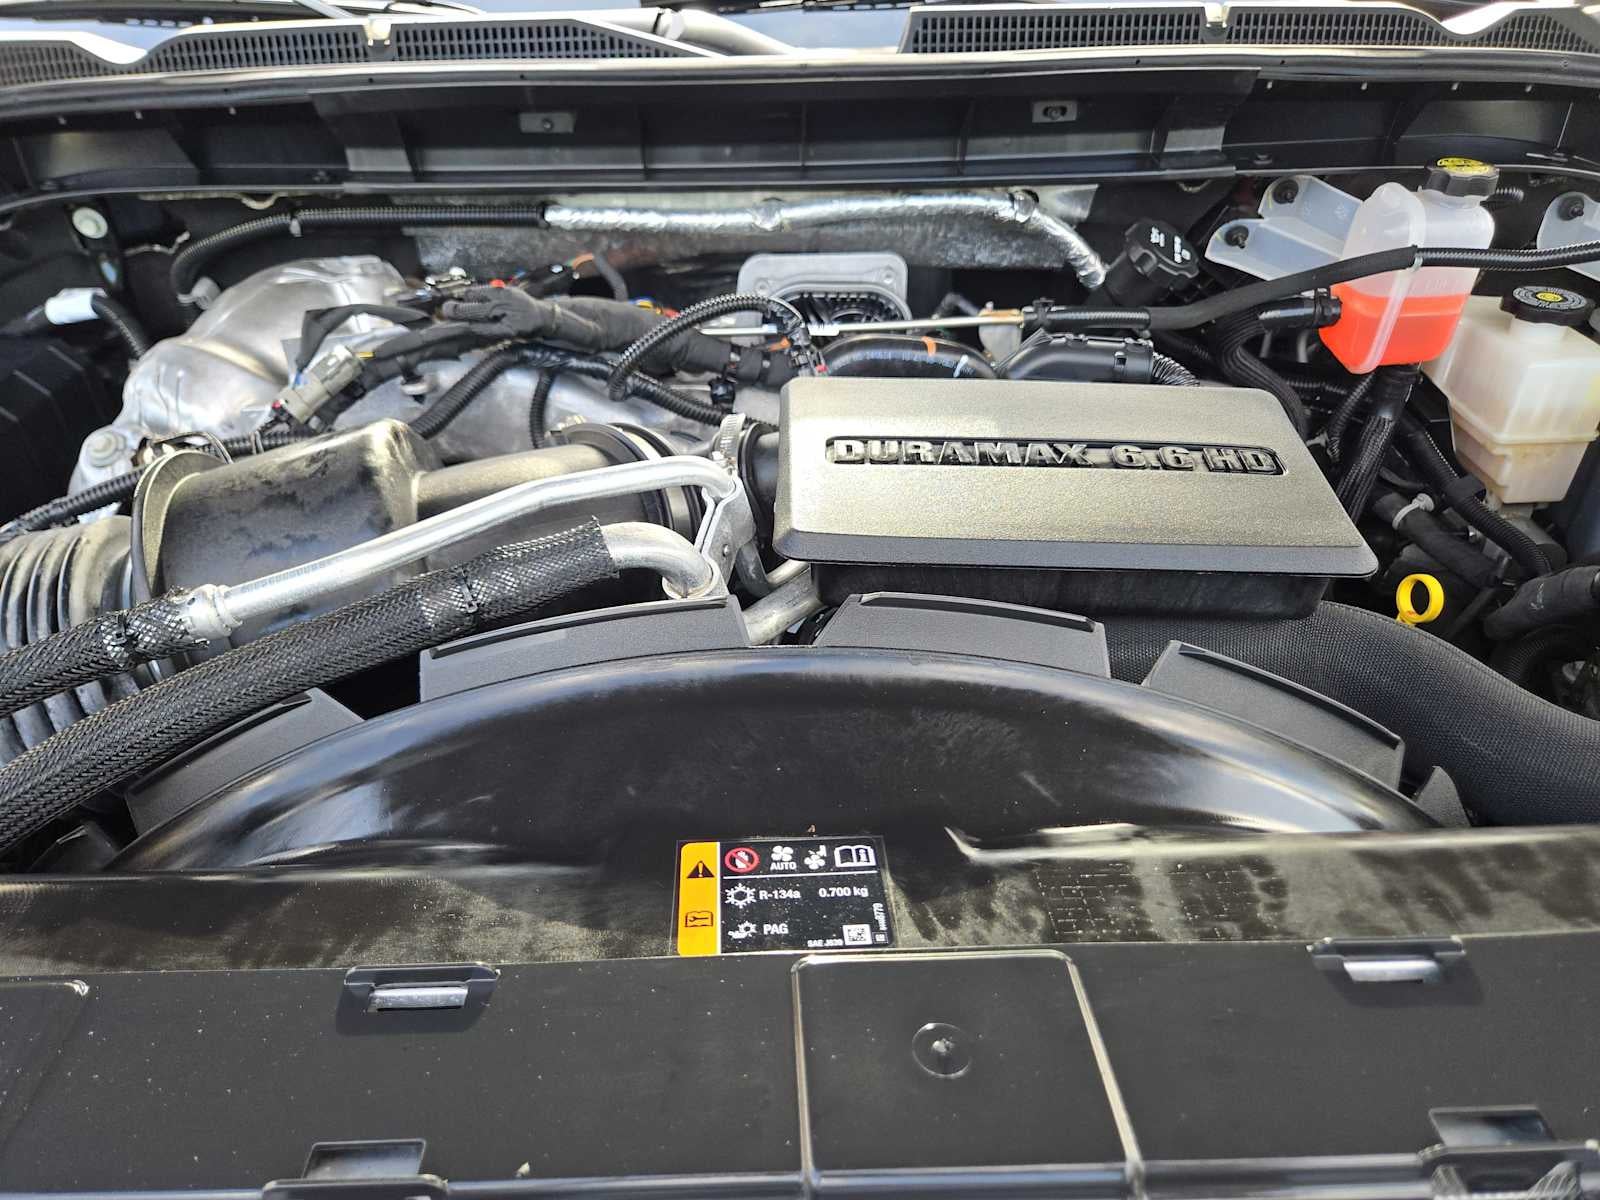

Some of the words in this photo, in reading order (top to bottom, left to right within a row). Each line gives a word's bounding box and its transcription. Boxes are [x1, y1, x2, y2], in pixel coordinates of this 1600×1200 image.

[833, 439, 1094, 466] DURAMAX
[1112, 445, 1195, 471] 6.6
[1201, 447, 1282, 474] HD
[770, 862, 797, 871] AUTO
[759, 889, 801, 900] R-134a
[819, 887, 850, 897] 0.700
[853, 886, 869, 898] kg
[763, 923, 789, 935] PAG
